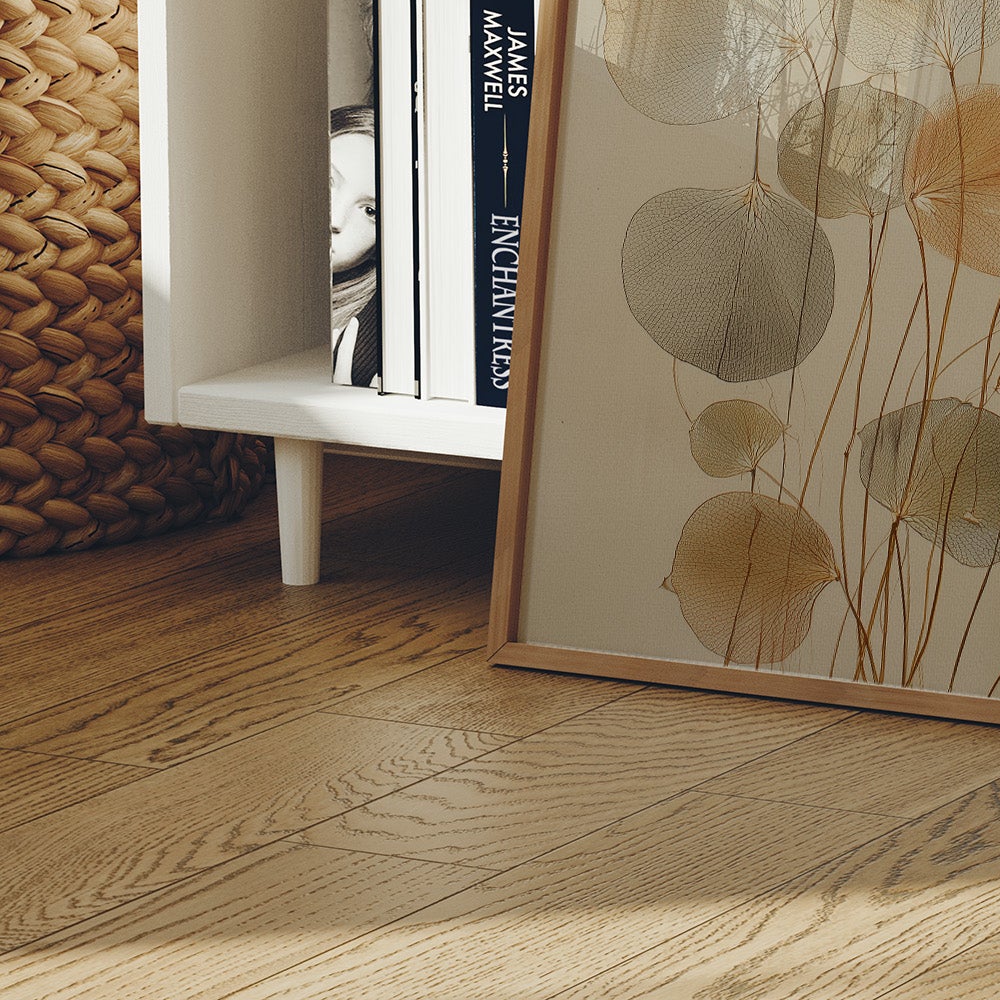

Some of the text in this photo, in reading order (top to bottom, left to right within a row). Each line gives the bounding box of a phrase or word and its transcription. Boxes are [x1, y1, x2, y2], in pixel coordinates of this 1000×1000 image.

[483, 9, 503, 112] MAXWELL
[507, 26, 528, 97] JAMES
[490, 213, 520, 390] ENCHANTRESS
